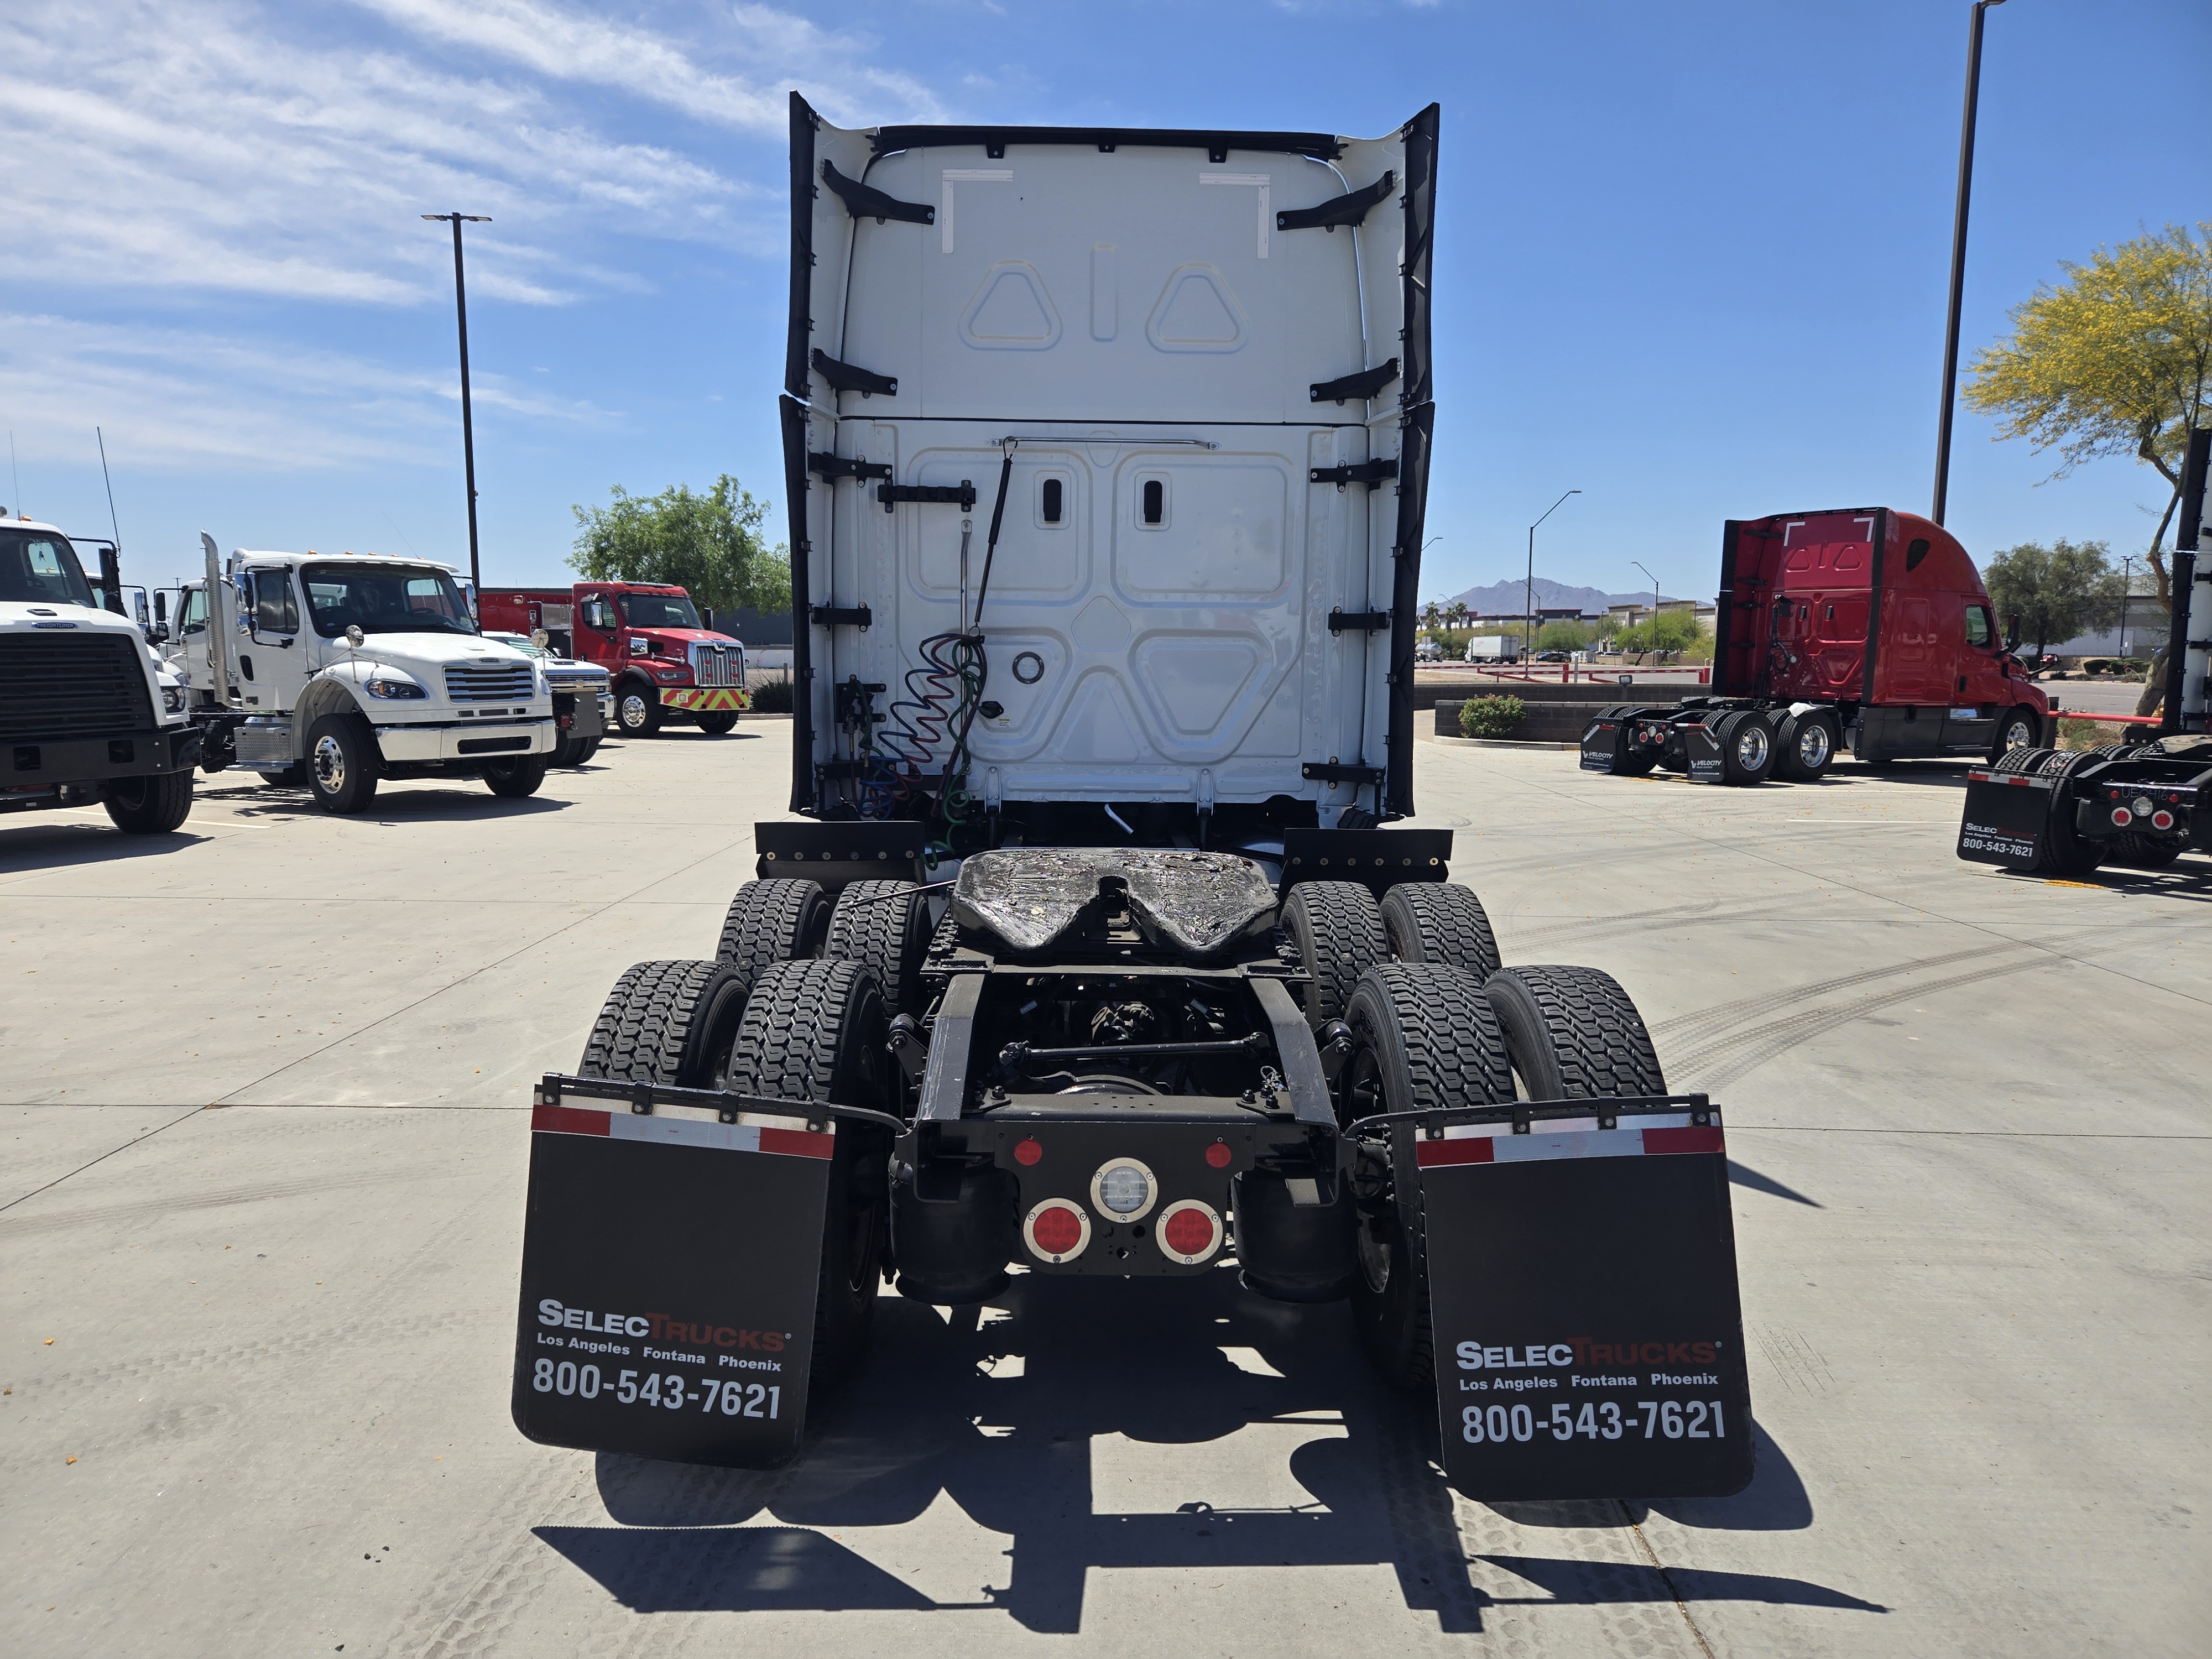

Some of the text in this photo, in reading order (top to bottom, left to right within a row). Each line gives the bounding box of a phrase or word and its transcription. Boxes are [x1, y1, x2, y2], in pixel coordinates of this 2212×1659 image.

[2121, 787, 2168, 801] UE0416
[1963, 838, 2033, 857] 800-543-7621
[537, 1332, 781, 1372] Los Angeles Fontana Phoenix
[533, 1358, 780, 1420] 800-543-7621
[1459, 1373, 1719, 1391] Los Angeles Fontana Phoenix
[1462, 1400, 1725, 1443] 800-543-7621
